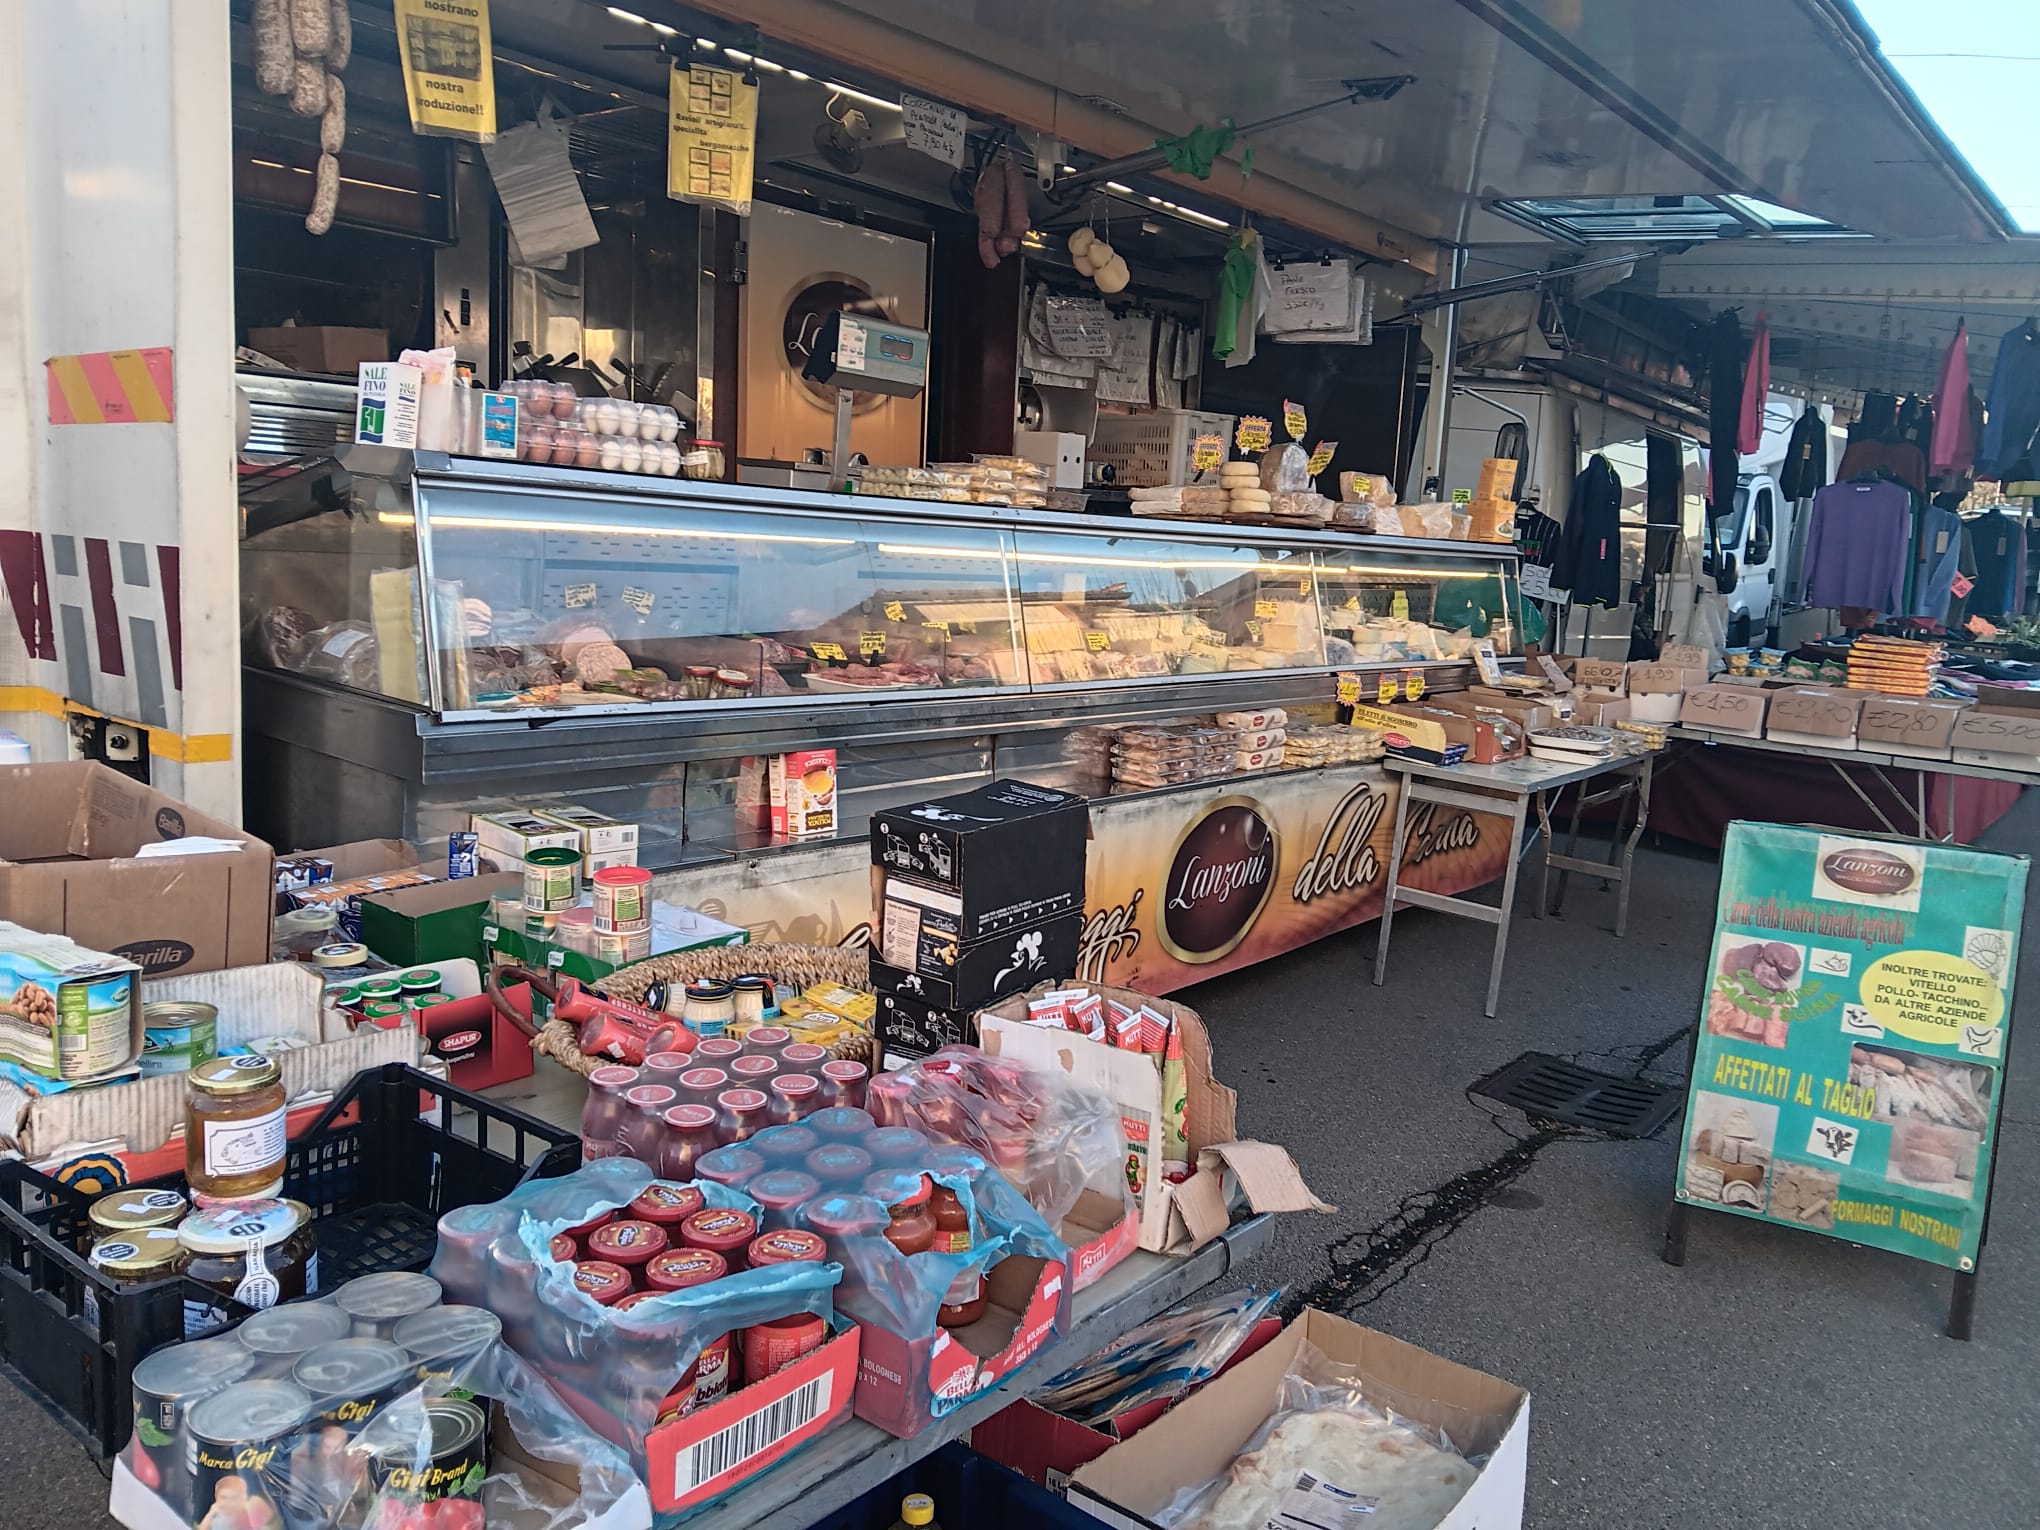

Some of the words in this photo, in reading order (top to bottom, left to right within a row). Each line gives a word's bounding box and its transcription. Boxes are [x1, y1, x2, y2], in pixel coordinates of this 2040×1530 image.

[425, 0, 478, 17] nostrano
[426, 80, 464, 93] nostra
[365, 367, 387, 380] SALE
[363, 380, 386, 391] FINO
[1690, 692, 1749, 713] €1,50
[1867, 710, 1938, 736] €2,80
[1293, 782, 1387, 902] della
[1826, 855, 1908, 878] Lanzoni
[1169, 845, 1267, 911] Lanzoni
[1756, 897, 1779, 928] della
[1784, 908, 1815, 933] nostra
[1820, 907, 1858, 939] azienda
[1862, 912, 1905, 950] agricola
[1882, 963, 1929, 977] INOLTRE
[1931, 970, 1988, 987] TROVATE:
[1909, 979, 1956, 993] VITELLO
[1877, 984, 1919, 998] POLLO-
[1874, 995, 1890, 1005] DA
[1895, 999, 1931, 1012] ALTRE
[1936, 1006, 1987, 1021] AZIENDE
[1898, 1011, 1958, 1028] AGRICOLE
[443, 1033, 477, 1048] SHAPUR
[1714, 1053, 1791, 1099] AFFETTATI
[1795, 1073, 1813, 1106] AL
[1824, 1079, 1876, 1121] TAGLIO
[1123, 1119, 1147, 1132] MUTTI
[1832, 1199, 1893, 1227] FORMAGGI
[1900, 1211, 1962, 1250] NOSTRANI
[863, 1358, 902, 1385] BOLOGNESE
[870, 1375, 878, 1386] 12
[337, 1400, 376, 1422] Gigi
[199, 1450, 233, 1469] Marca
[235, 1445, 277, 1473] Gigi
[389, 1466, 432, 1492] Gigi
[430, 1457, 469, 1487] Brand
